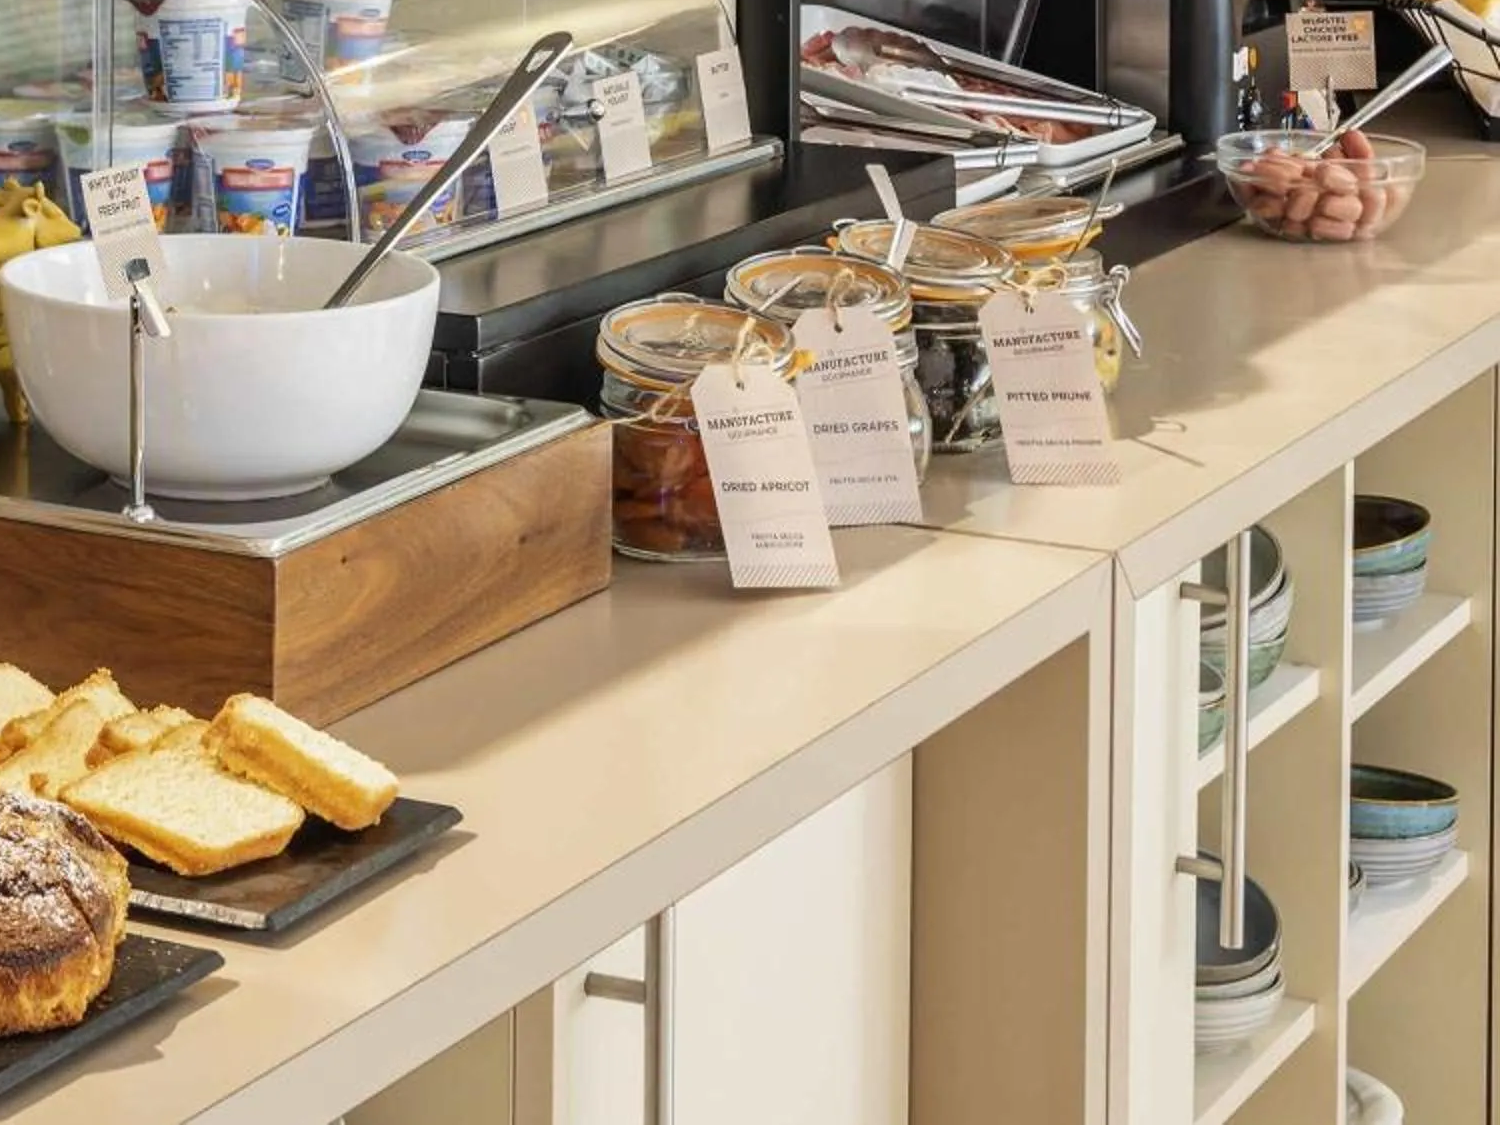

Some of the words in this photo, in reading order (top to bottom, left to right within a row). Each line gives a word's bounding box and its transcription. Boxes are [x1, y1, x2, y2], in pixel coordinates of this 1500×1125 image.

[992, 330, 1082, 348] MANUFACTURE
[1006, 391, 1049, 403] PITTED
[1051, 391, 1092, 403] PRUNE
[707, 410, 795, 431] MANUFACTURE
[813, 422, 850, 436] DRIED
[852, 420, 899, 434] GRAPES
[721, 481, 757, 493] DRIED
[760, 480, 809, 492] APRICOT
